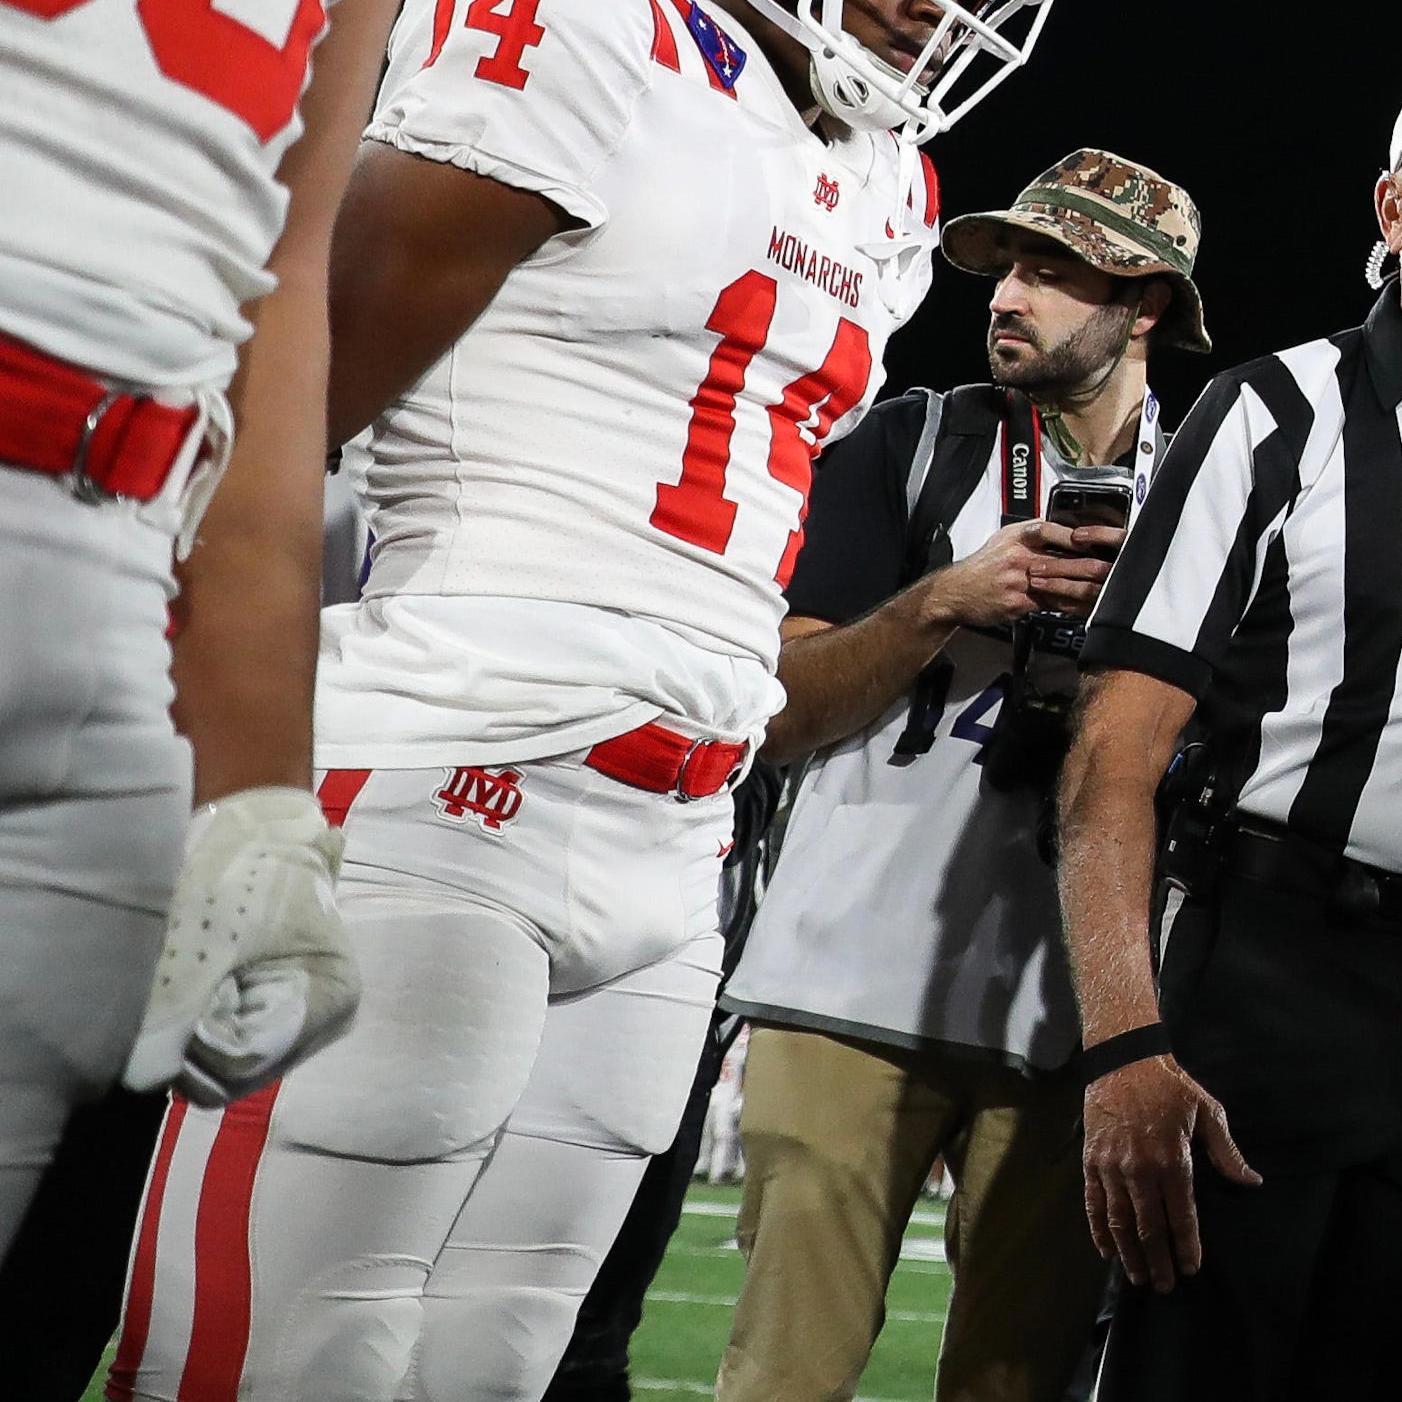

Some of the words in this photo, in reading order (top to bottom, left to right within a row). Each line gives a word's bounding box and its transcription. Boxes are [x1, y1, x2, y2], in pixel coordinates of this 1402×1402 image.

[767, 225, 863, 308] MONARCHS
[649, 269, 872, 592] 14
[1012, 443, 1030, 499] Canon
